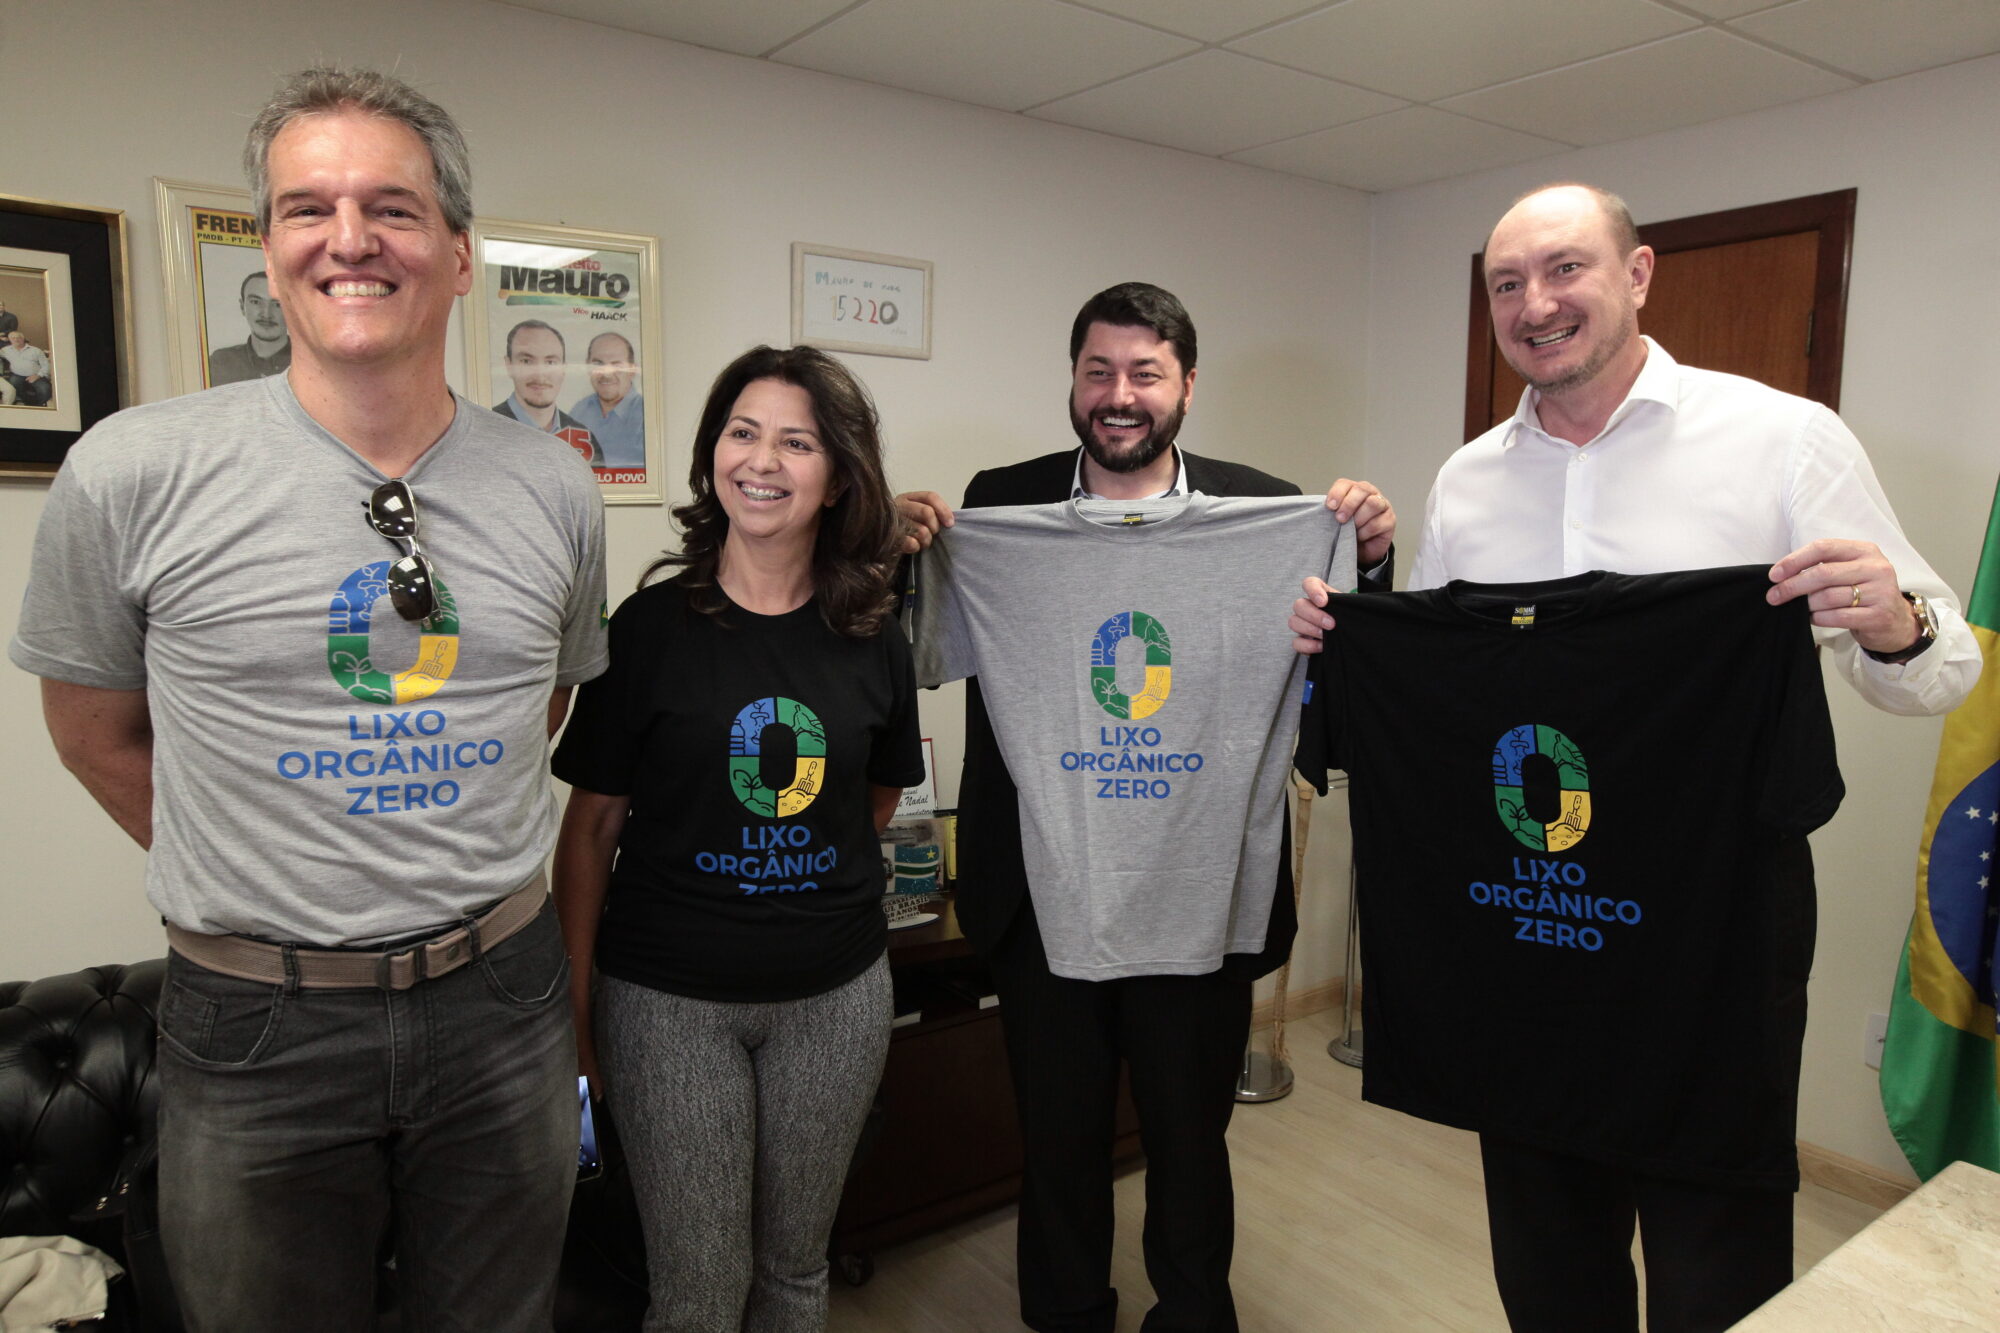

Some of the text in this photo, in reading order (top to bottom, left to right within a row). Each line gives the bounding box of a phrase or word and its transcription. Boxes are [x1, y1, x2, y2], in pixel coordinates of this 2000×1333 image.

[196, 213, 257, 235] FREN
[197, 232, 224, 242] PMDB
[231, 236, 243, 244] PT
[500, 264, 630, 299] Mauro
[590, 311, 628, 322] HAACK
[615, 473, 645, 483] POVO
[348, 709, 447, 740] LIXO
[1100, 726, 1162, 747] LIXO
[276, 739, 504, 780] ORGÂNICO
[1060, 747, 1204, 773] ORGÂNICO
[345, 779, 461, 815] ZERO
[905, 794, 929, 807] Nadal
[1096, 778, 1171, 799] ZERO
[742, 825, 812, 849] LIXO
[1513, 856, 1587, 887] LIXO
[898, 896, 930, 909] BRASIL
[1469, 881, 1642, 925] ORGÂNICO
[1513, 916, 1604, 951] ZERO
